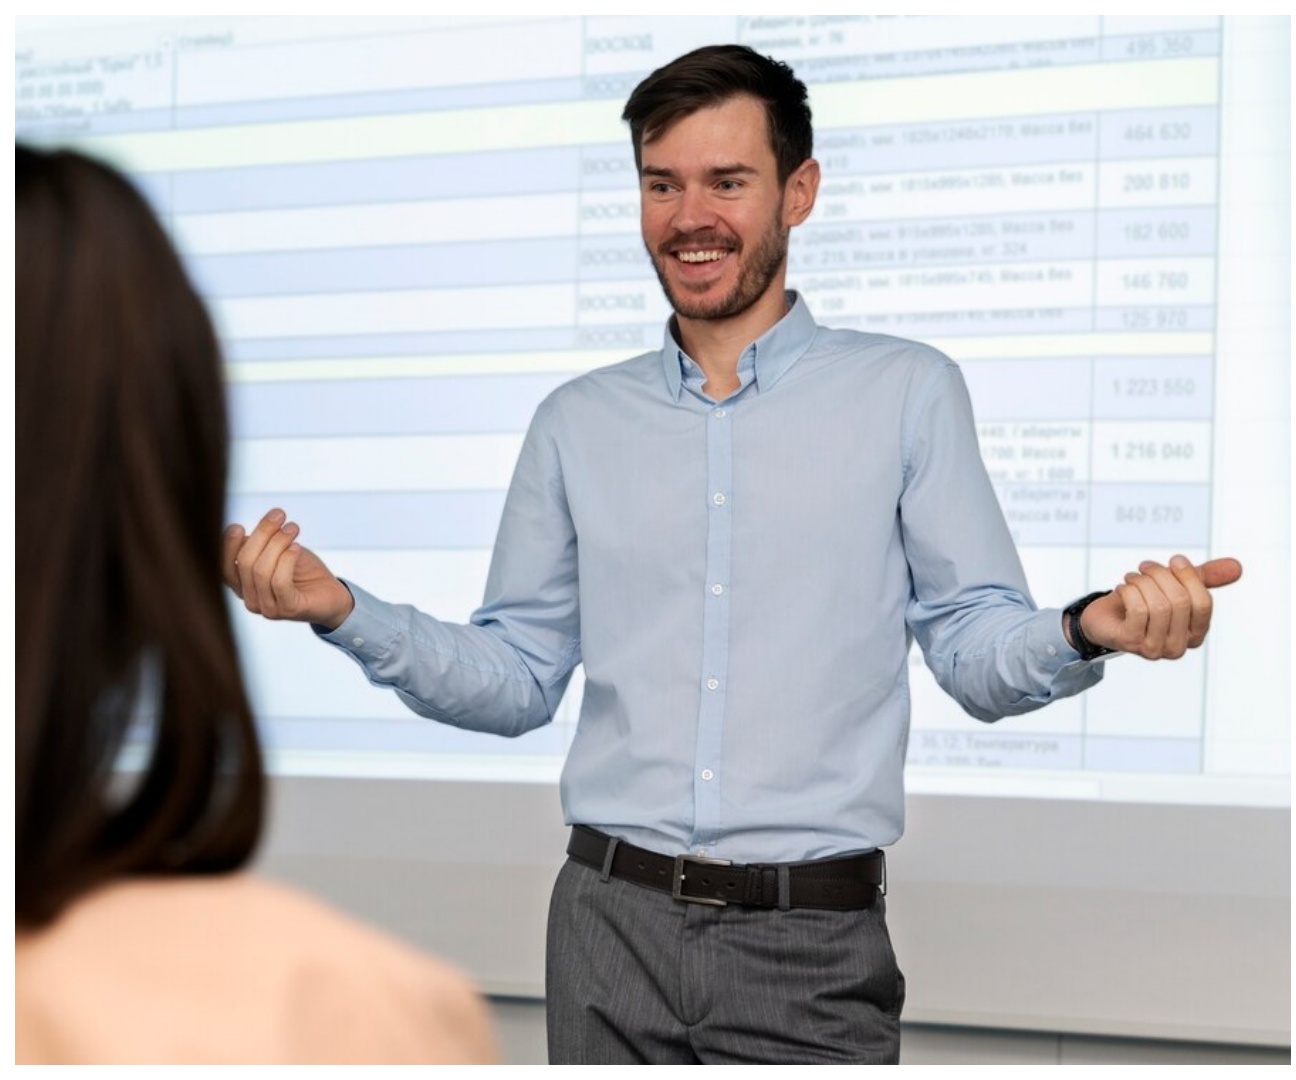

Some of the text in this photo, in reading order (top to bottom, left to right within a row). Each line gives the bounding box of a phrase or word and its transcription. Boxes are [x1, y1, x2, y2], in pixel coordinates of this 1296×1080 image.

[1123, 122, 1191, 141] 464 630
[1123, 174, 1153, 192] 200
[1124, 222, 1190, 241] 182 600
[1122, 271, 1189, 290] 146 760
[1127, 378, 1158, 396] 223
[1125, 443, 1157, 459] 216
[1161, 442, 1194, 460] 040
[1151, 505, 1183, 523] 570
